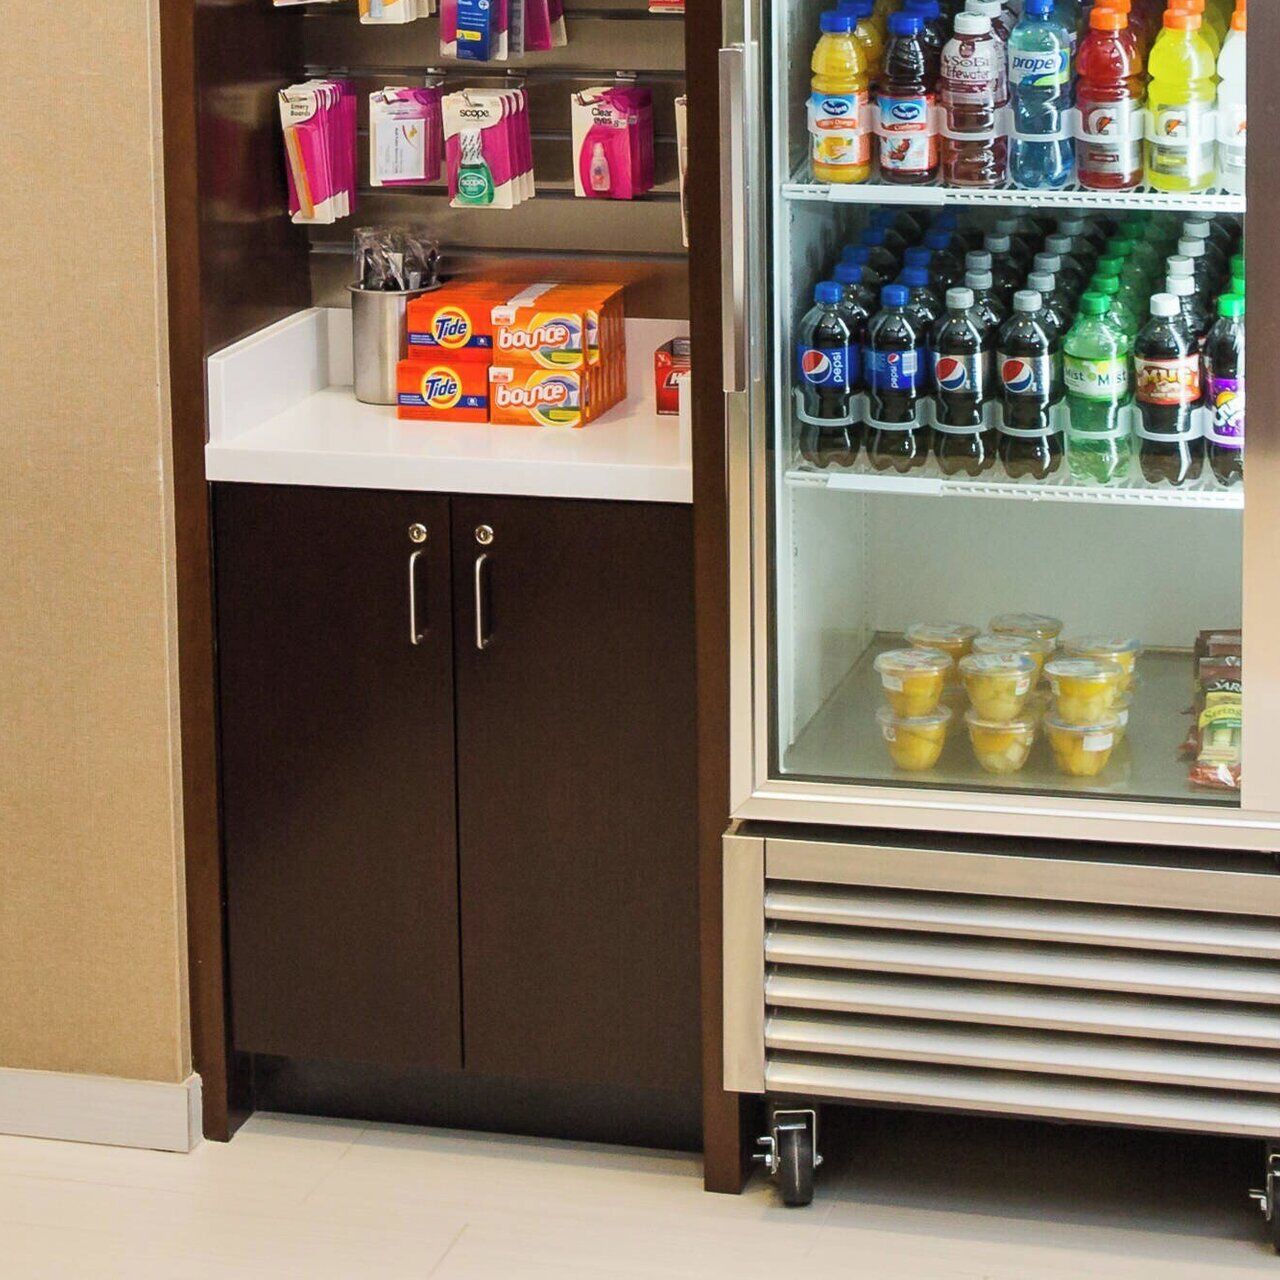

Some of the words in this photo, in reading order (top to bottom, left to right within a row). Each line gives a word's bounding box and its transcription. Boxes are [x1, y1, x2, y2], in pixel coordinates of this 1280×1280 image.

[1012, 56, 1057, 72] prope
[459, 108, 490, 118] scope
[591, 107, 613, 117] Clear
[436, 317, 468, 340] Tide
[499, 325, 567, 350] bounce
[830, 351, 845, 384] pepsi
[1097, 370, 1126, 387] Mst
[426, 377, 458, 401] Tide
[497, 382, 566, 408] bounce
